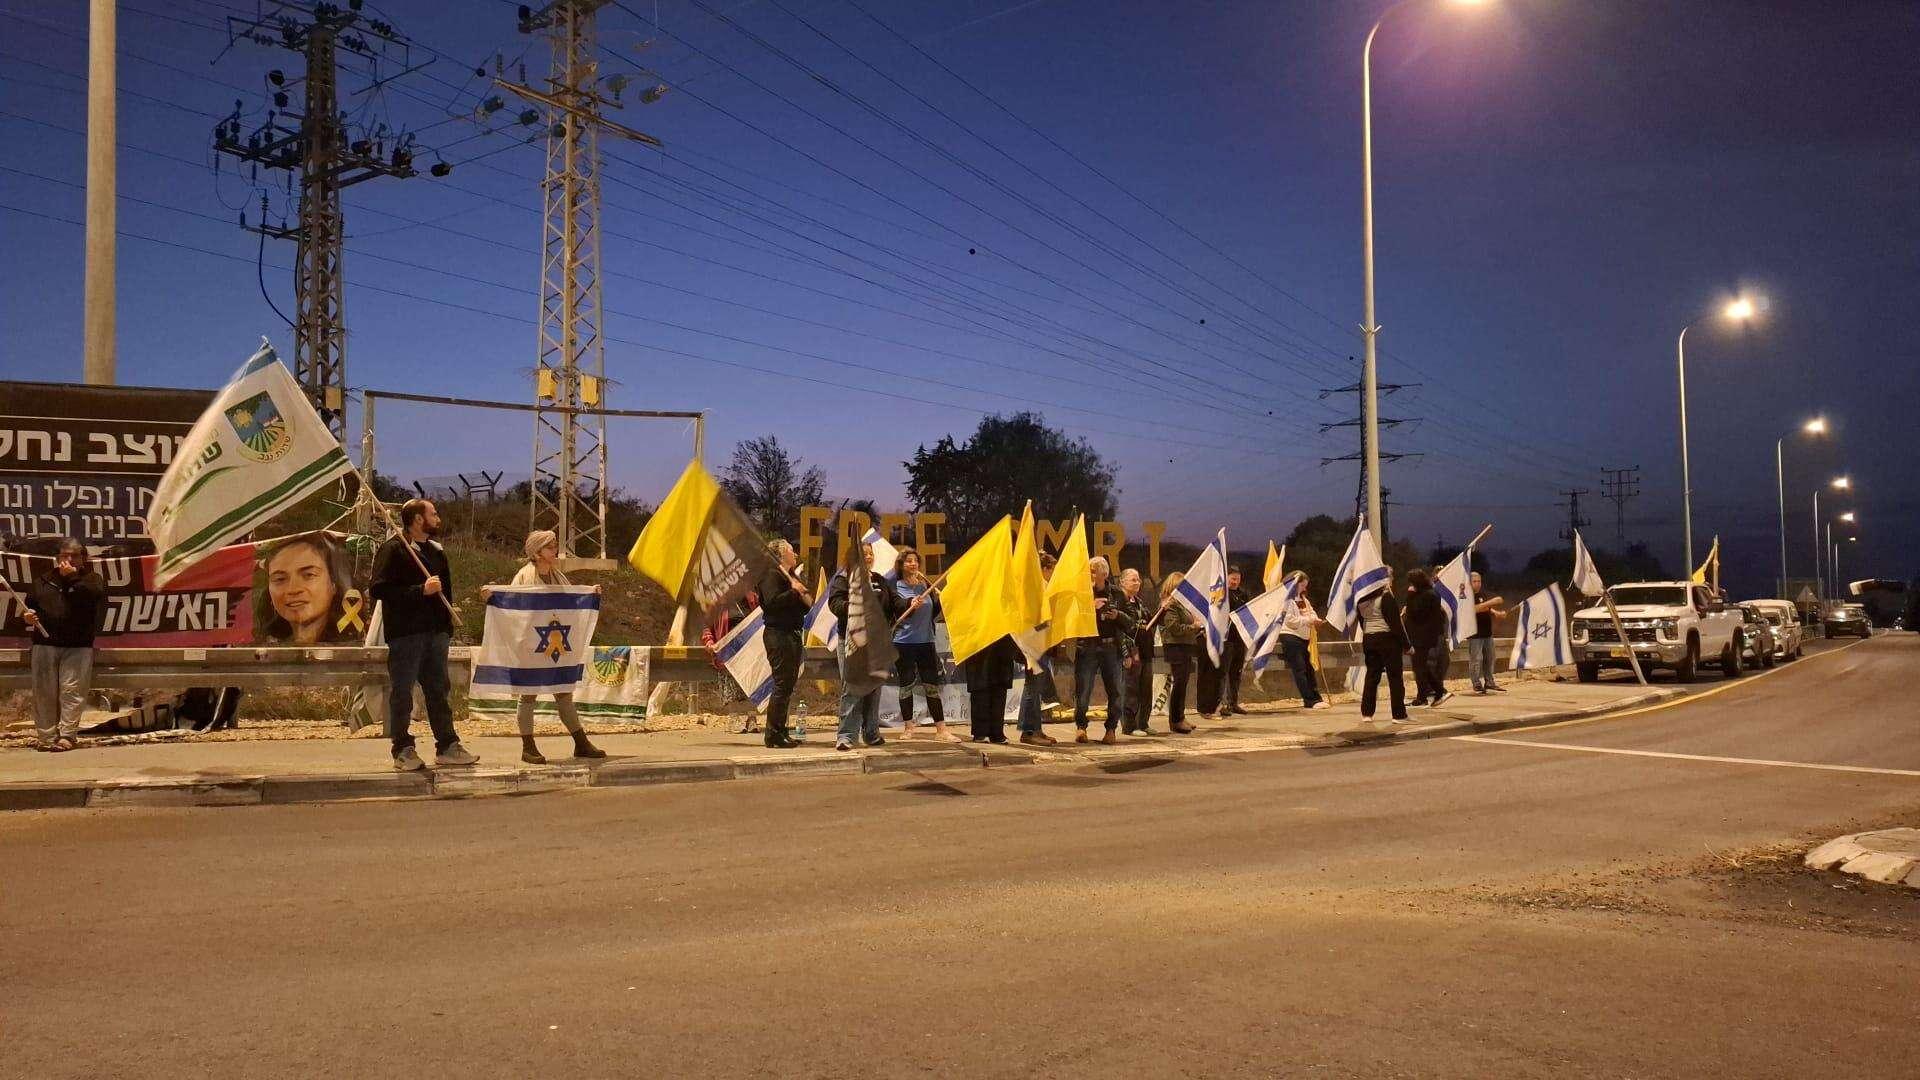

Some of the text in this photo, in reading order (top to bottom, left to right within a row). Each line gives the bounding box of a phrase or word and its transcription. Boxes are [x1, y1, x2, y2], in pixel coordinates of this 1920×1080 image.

[88, 432, 186, 464] וצב
[43, 479, 114, 510] נפלו
[103, 590, 228, 632] האישה
